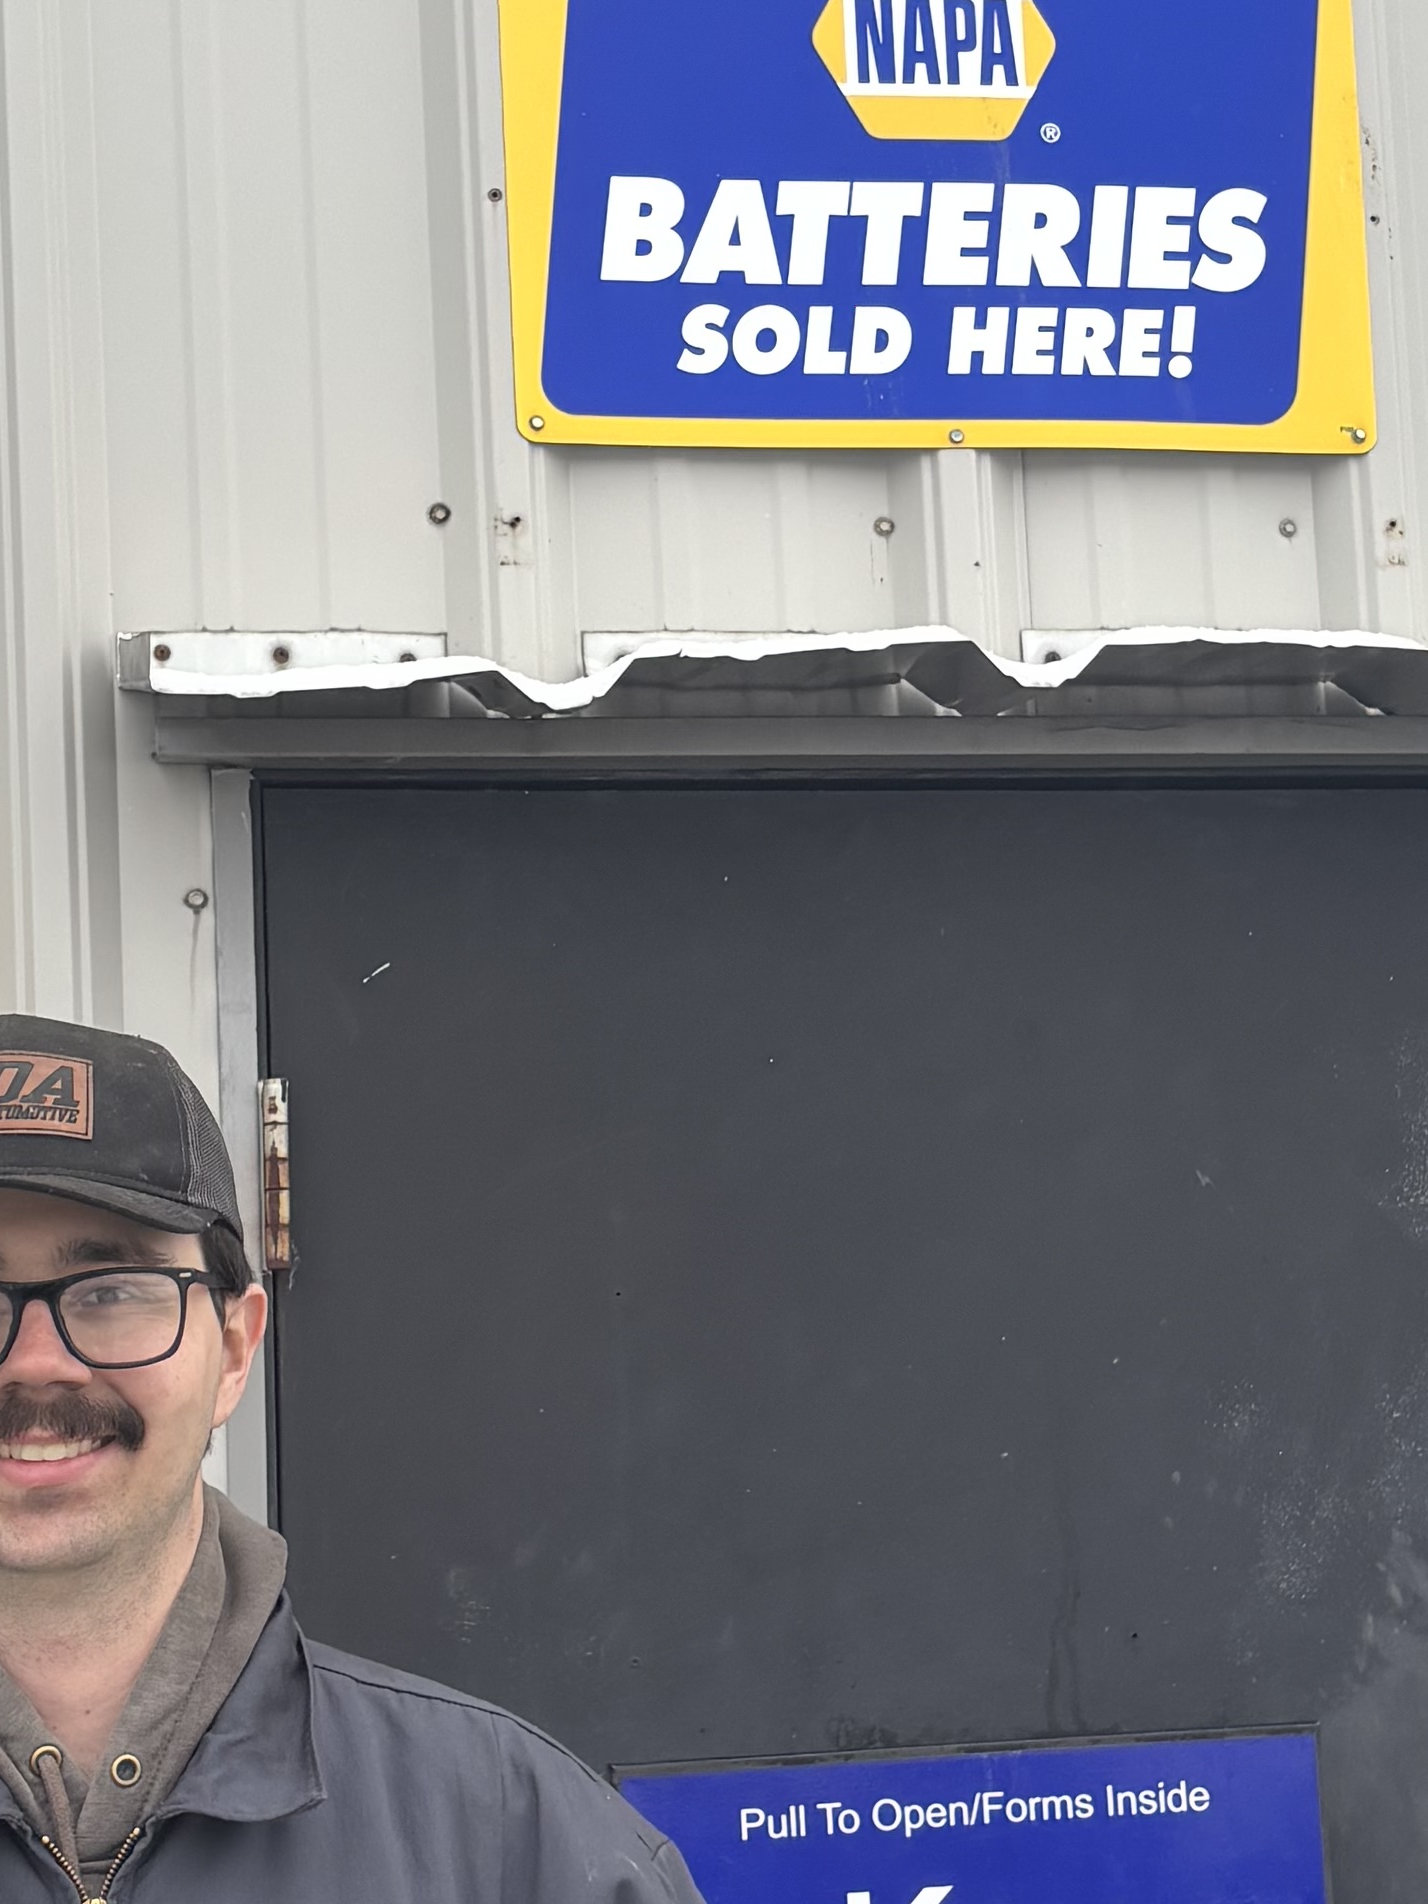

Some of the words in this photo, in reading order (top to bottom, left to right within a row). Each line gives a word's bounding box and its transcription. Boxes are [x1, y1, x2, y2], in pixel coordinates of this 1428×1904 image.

[600, 175, 1268, 293] BATTERIES
[676, 303, 913, 375] SOLD
[947, 305, 1197, 379] HERE!
[740, 1804, 806, 1841] Pull
[816, 1801, 861, 1835] To
[871, 1791, 1095, 1838] Open/Forms
[1106, 1780, 1210, 1817] Inside
